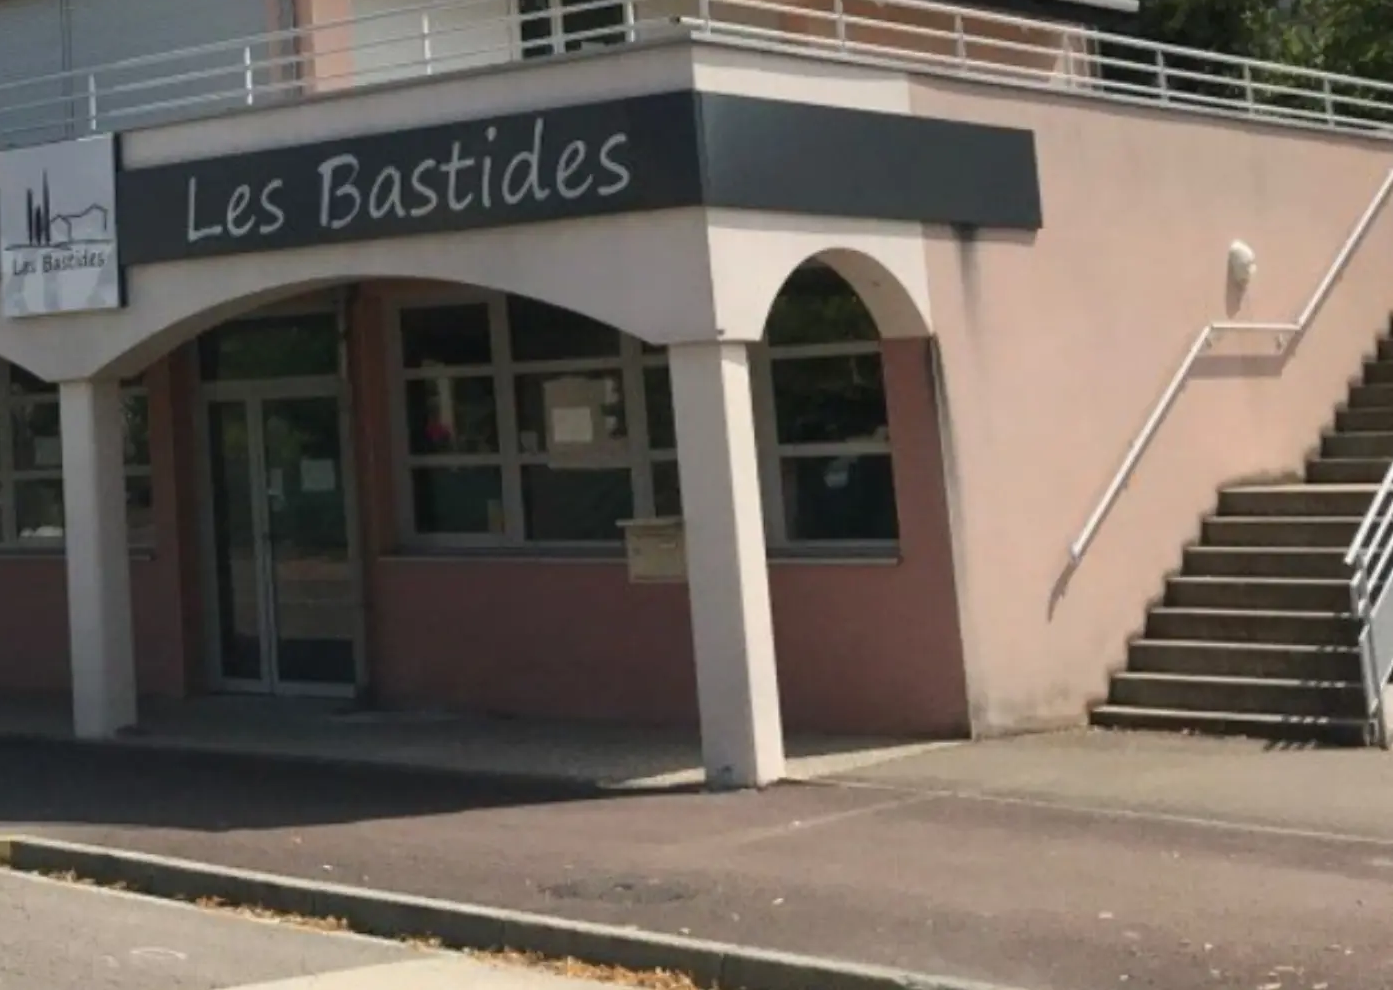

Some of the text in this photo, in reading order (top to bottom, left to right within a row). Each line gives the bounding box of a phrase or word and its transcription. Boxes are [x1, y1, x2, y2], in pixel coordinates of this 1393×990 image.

[186, 117, 632, 243] Les Bastides
[12, 250, 106, 276] Les Bastides
